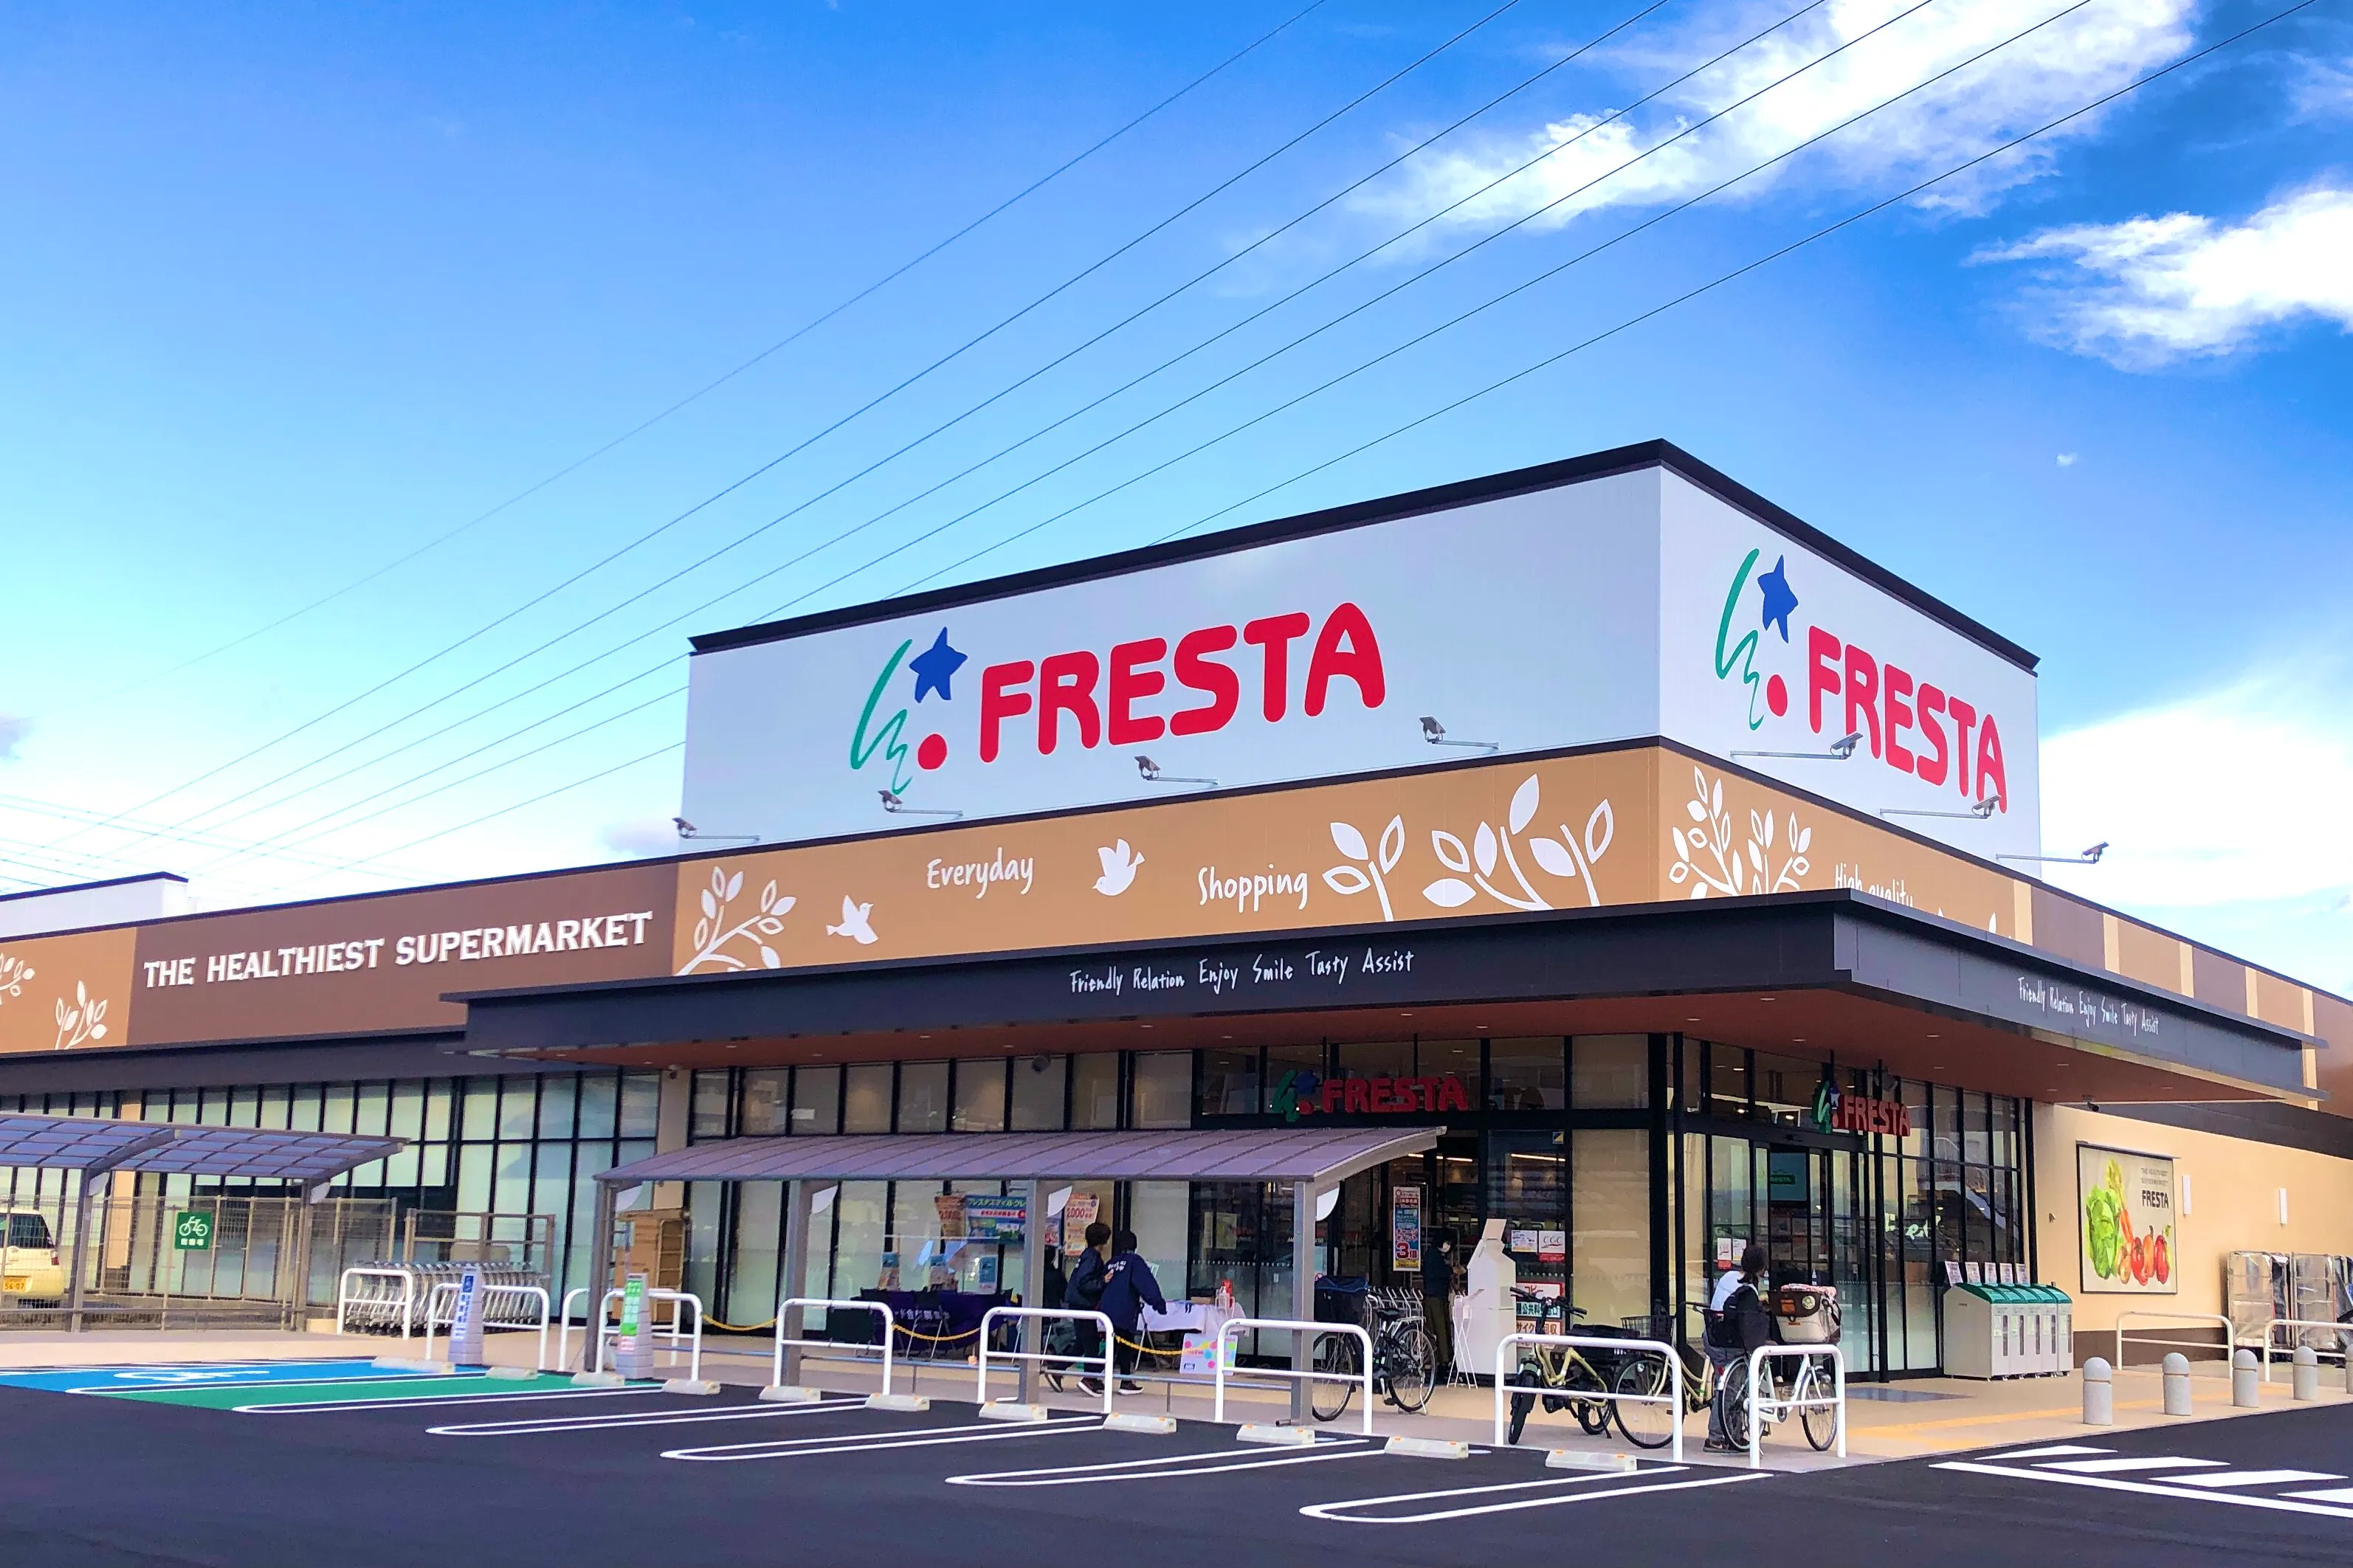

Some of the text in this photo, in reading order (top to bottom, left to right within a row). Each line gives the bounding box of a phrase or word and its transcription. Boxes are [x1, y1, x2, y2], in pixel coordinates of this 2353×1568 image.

[980, 602, 1385, 763] FRESTA
[1808, 625, 2008, 814] FRESTA
[927, 847, 1033, 899] Everyday
[1199, 863, 1308, 913] Shopping
[144, 910, 654, 988] THE HEALTHIEST SUPERMARKET
[1069, 947, 1415, 996] Friendly Relation Enjoy Smile Tasty Assist
[2017, 976, 2160, 1037] Friendly Relation Enjoy Smile Tasty Assist
[1322, 1075, 1469, 1113] FRESTA
[1841, 1094, 1911, 1137] FRESTA
[2142, 1189, 2169, 1209] FRESTA
